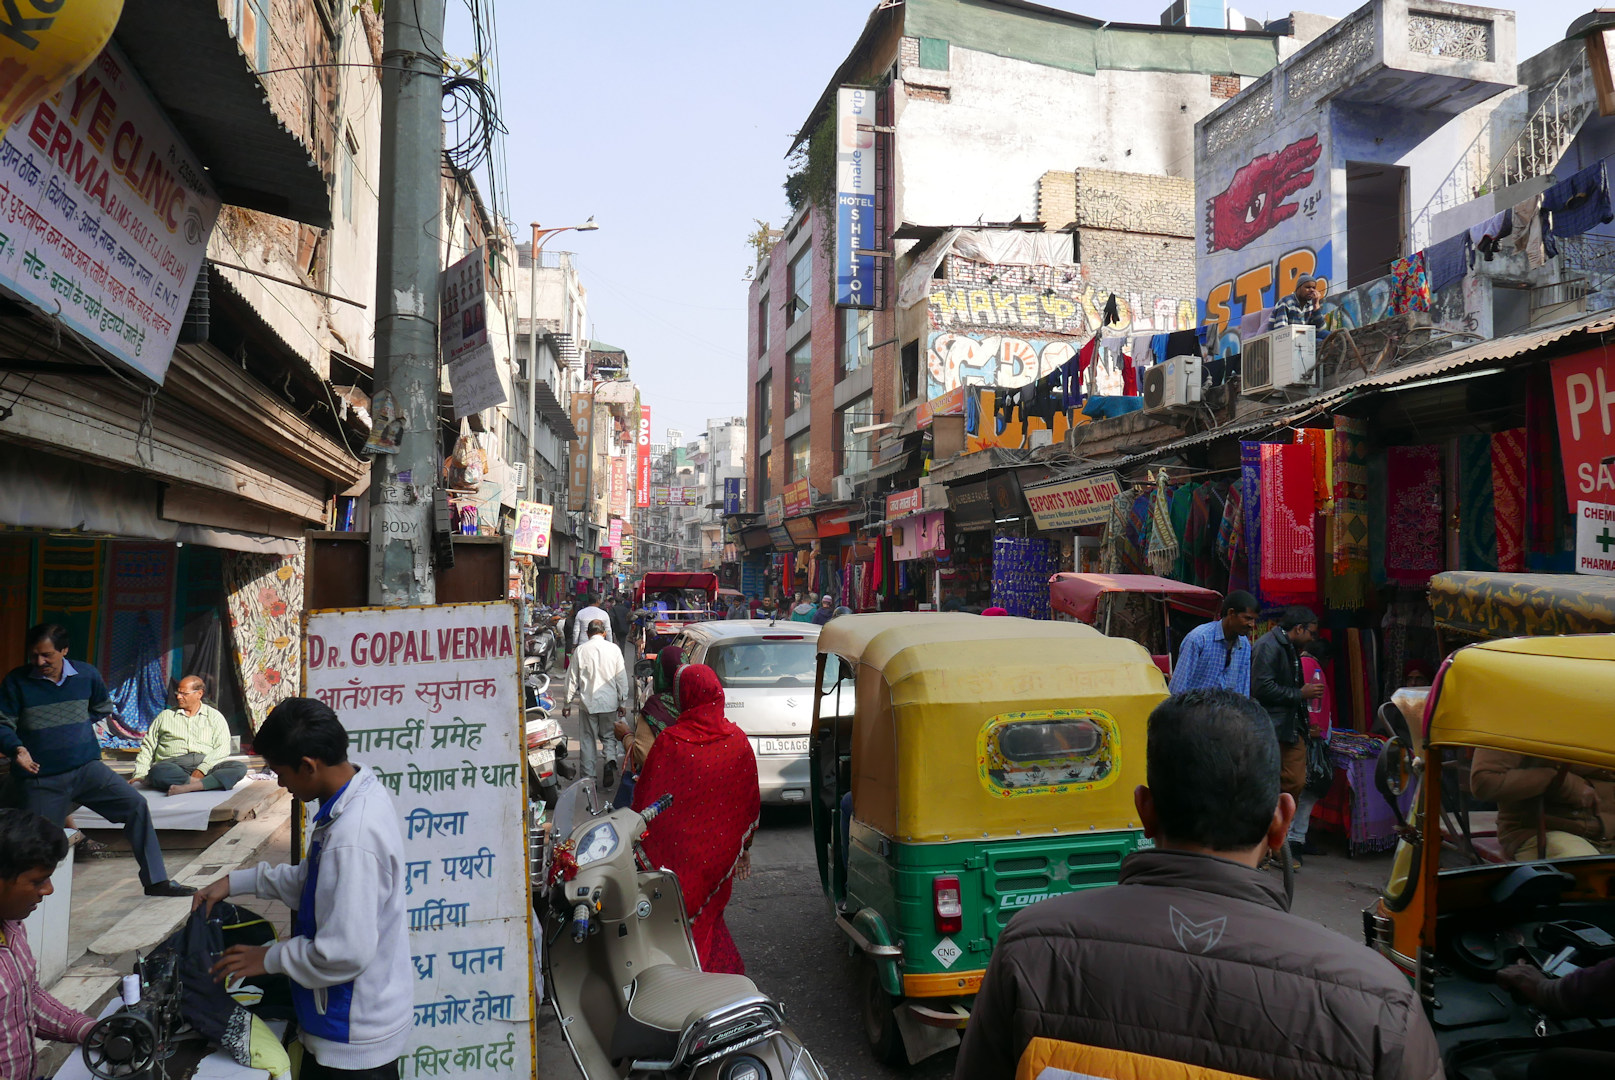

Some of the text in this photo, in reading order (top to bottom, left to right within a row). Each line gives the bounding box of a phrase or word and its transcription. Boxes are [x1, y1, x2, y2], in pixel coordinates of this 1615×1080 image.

[14, 100, 110, 208] ERMA
[50, 74, 188, 235] YE CLINIC
[851, 150, 862, 188] make
[840, 196, 873, 207] HOTEL
[850, 208, 862, 305] SHELTON
[575, 399, 589, 487] PAYAL
[638, 418, 649, 446] OYO
[1028, 482, 1119, 513] EXPORTS TRADE INDIA
[381, 521, 418, 533] BODY
[350, 629, 433, 665] GOPAL
[437, 625, 513, 660] VERMA
[415, 678, 496, 713] सुजाक
[430, 716, 487, 751] प्रमेह
[372, 766, 404, 796] ोष
[404, 808, 469, 840] गिरना
[441, 847, 496, 881] पथरी
[448, 946, 505, 975] पतन
[937, 948, 956, 957] CNG
[471, 990, 515, 1026] होना
[716, 1023, 748, 1040] Jupiter
[722, 1034, 762, 1055] Jupiter
[412, 1045, 453, 1079] सिर
[453, 1043, 485, 1072] का
[484, 1033, 516, 1073] दर्द
